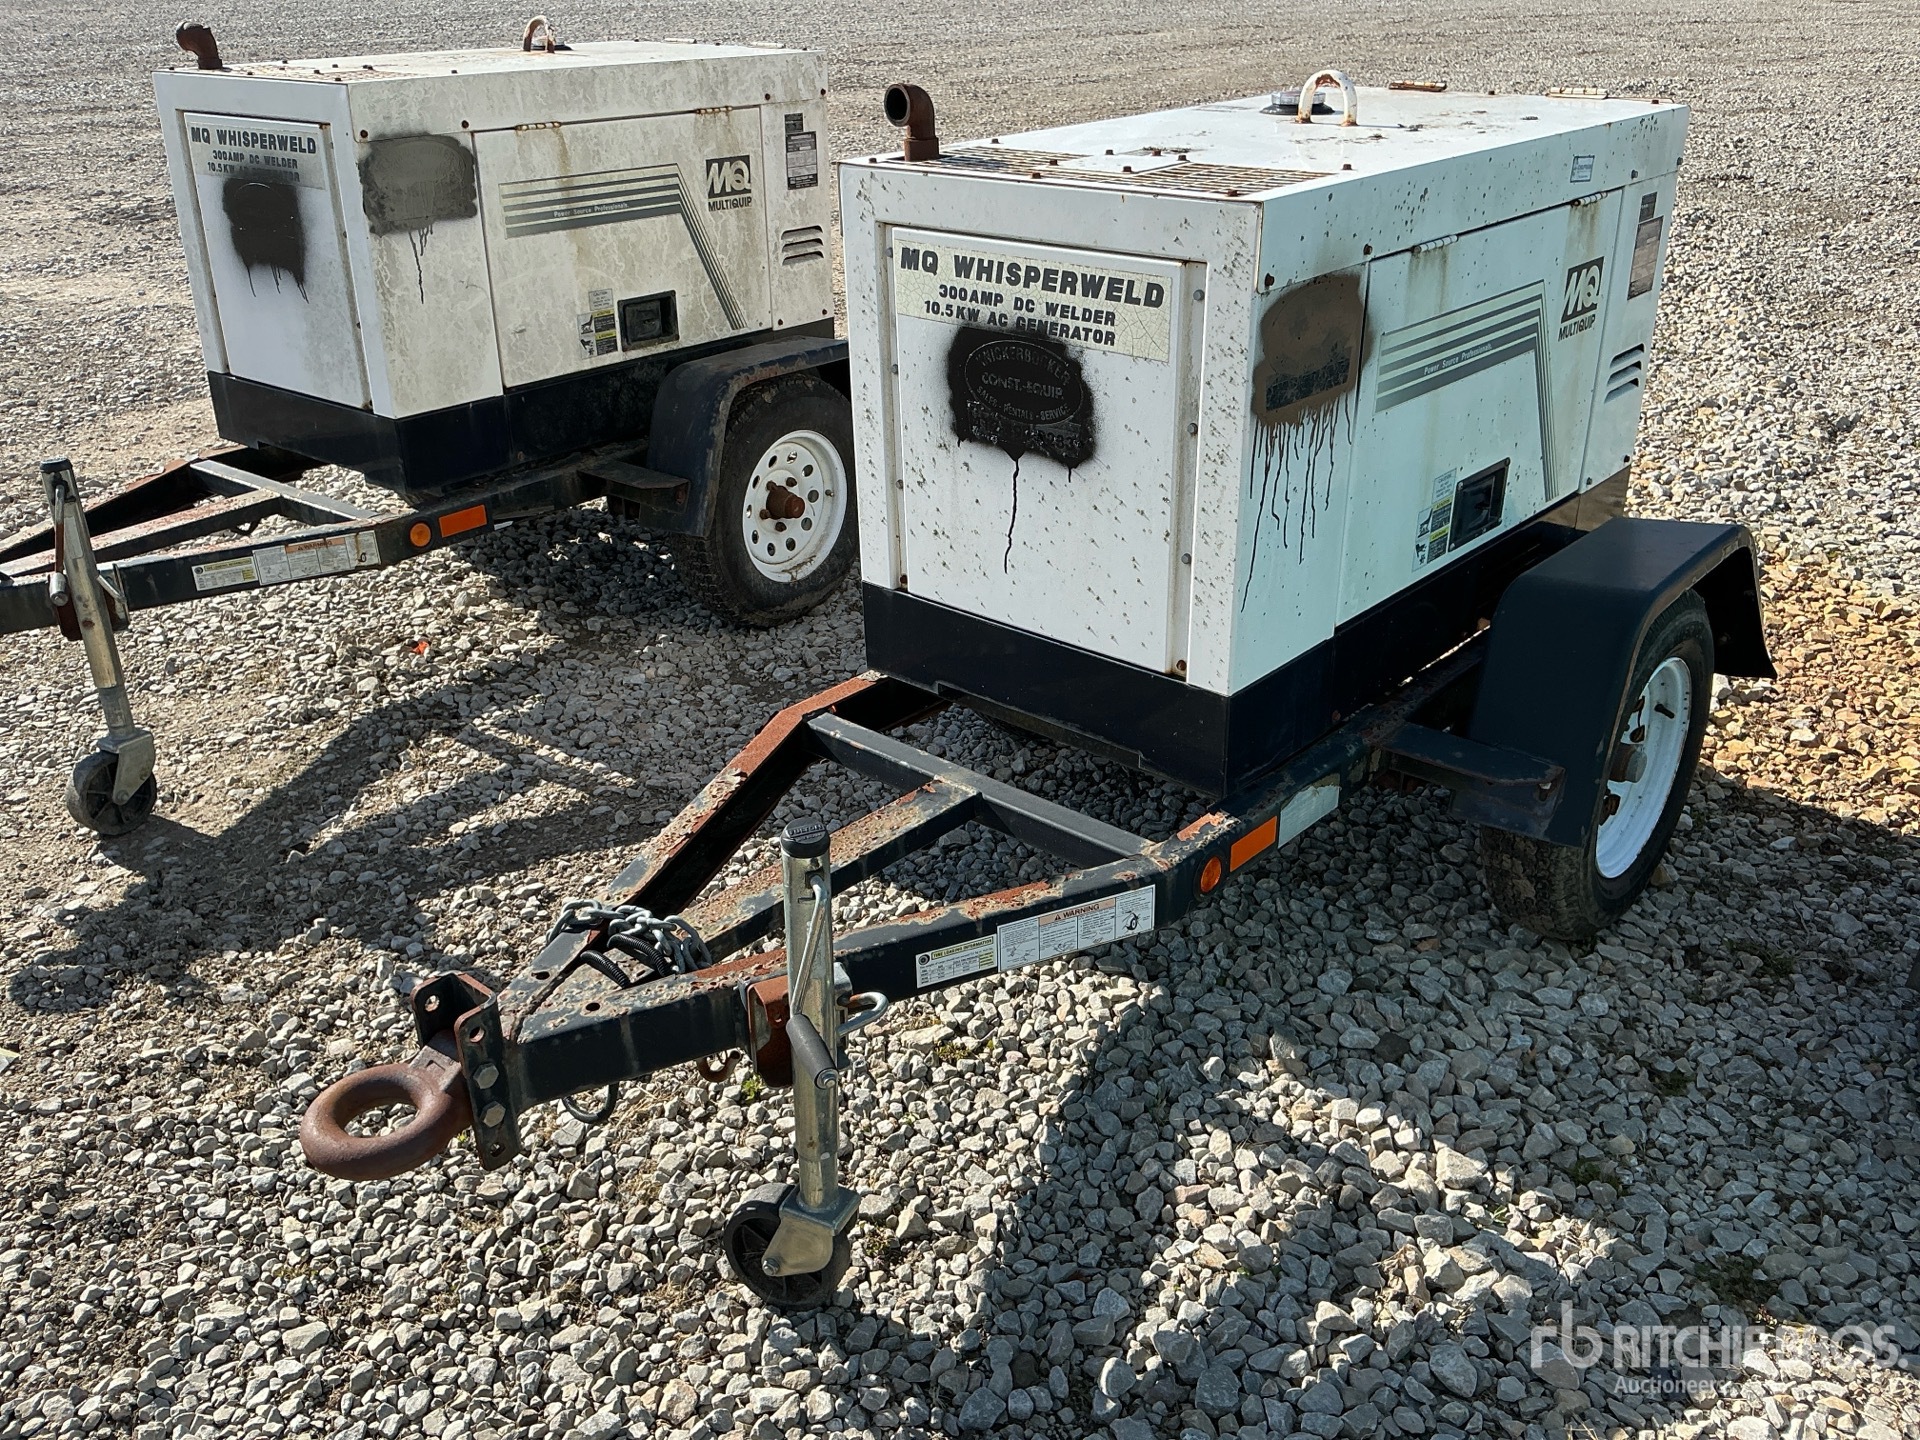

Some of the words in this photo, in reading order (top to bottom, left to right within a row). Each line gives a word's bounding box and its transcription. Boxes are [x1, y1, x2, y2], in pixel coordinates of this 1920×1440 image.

[190, 126, 211, 145] MQ
[216, 129, 317, 154] WHISPERWELD
[207, 162, 235, 173] 10.5KW
[212, 150, 245, 163] 300AMP
[249, 154, 261, 165] DC
[263, 155, 298, 169] WELDER
[706, 159, 752, 194] MQ
[553, 210, 571, 218] Power
[573, 208, 593, 216] Source
[708, 196, 753, 212] MULTIQUIP
[900, 246, 939, 275] MQ
[953, 254, 1165, 309] WHISPERWELD
[1563, 264, 1603, 316] MQ
[938, 284, 1004, 308] 300AMP
[1013, 297, 1036, 313] DC
[1045, 301, 1116, 327] WELDER
[924, 300, 980, 322] 10.5KW
[987, 312, 1008, 328] AC
[1015, 315, 1116, 346] GENERATOR
[1557, 313, 1597, 342] MULTIQUIP
[1423, 363, 1440, 375] Power
[1441, 356, 1460, 368] Source
[1062, 903, 1100, 919] WARNING
